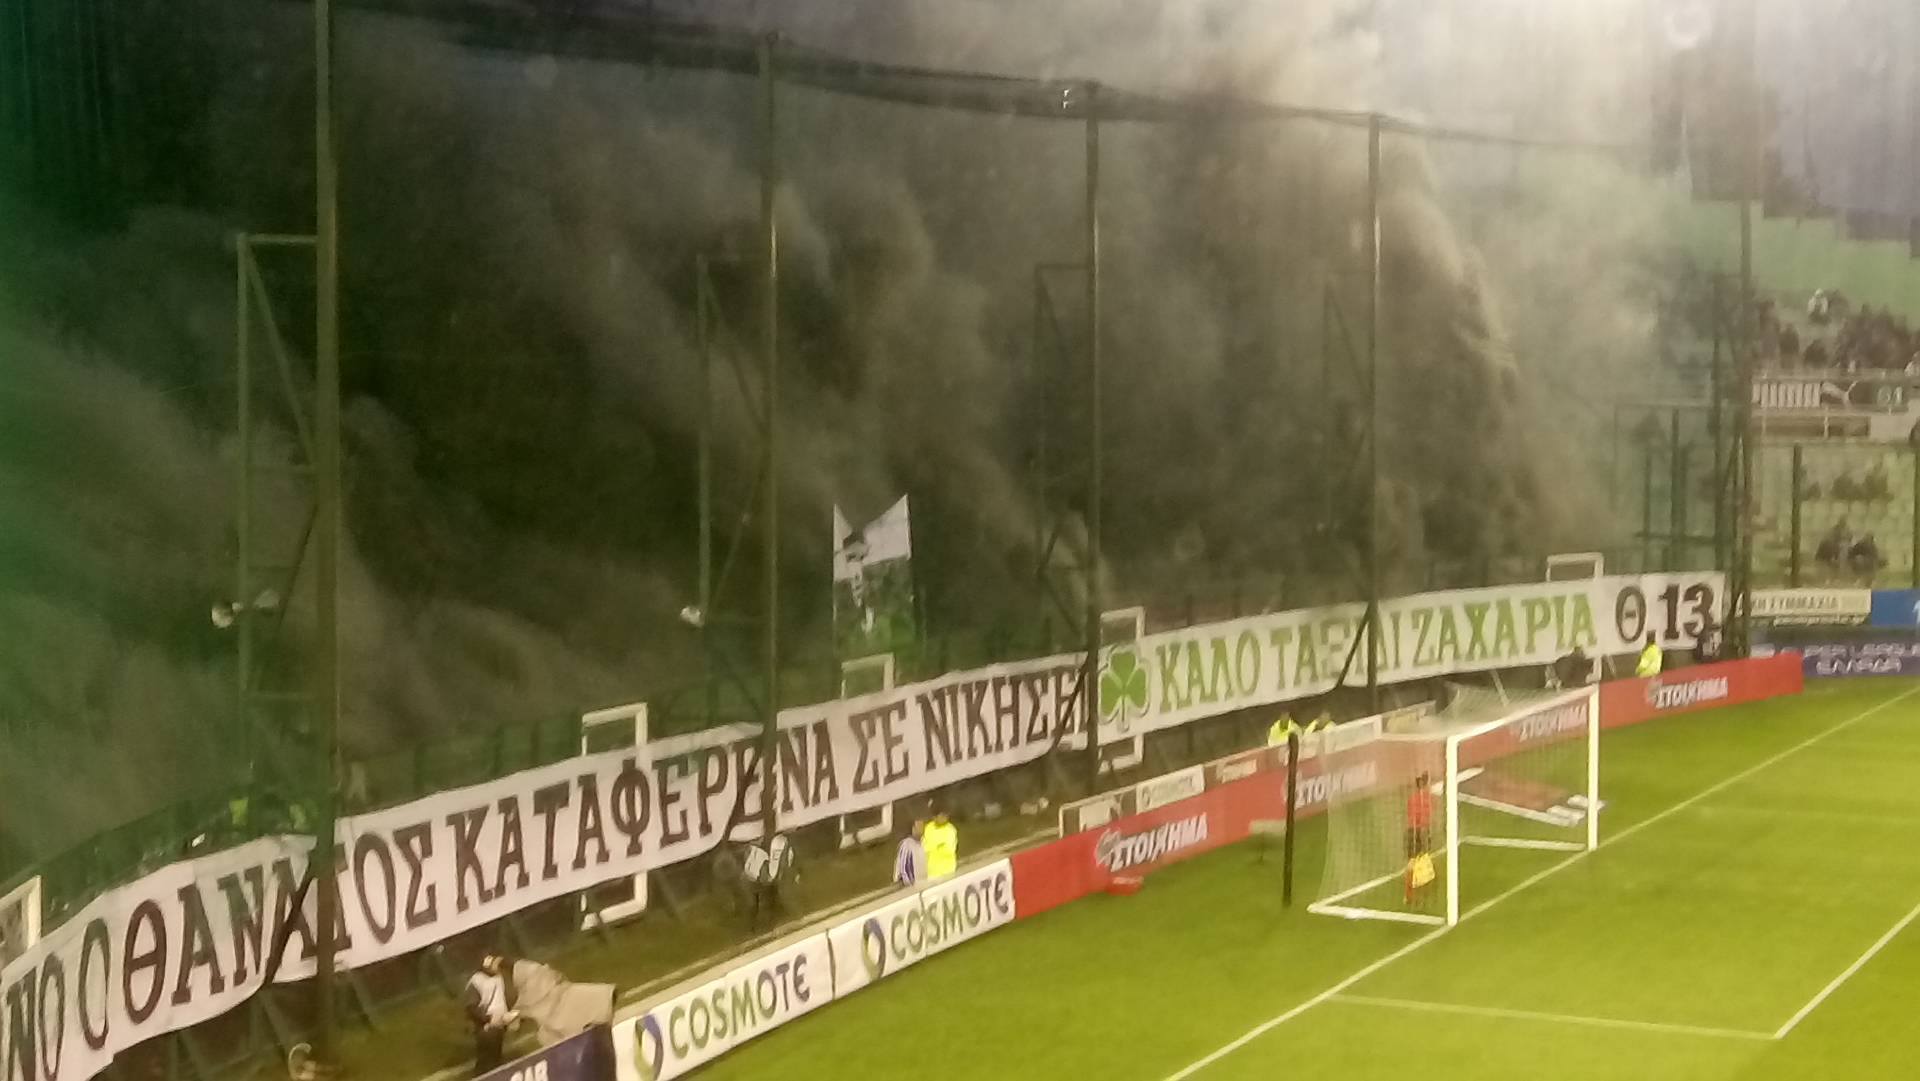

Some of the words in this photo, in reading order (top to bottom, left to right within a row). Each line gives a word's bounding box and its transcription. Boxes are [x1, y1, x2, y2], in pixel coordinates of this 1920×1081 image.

[1156, 629, 1261, 714] ΚΑΛΟ
[1411, 593, 1597, 668] ΖΑΧΑΡΙΑ
[78, 918, 111, 1050] Ο
[446, 738, 768, 913] ΚΑΤΑΦΕΡΕ
[776, 718, 839, 812] ΝΑ
[849, 699, 910, 795] ΣΕ
[891, 872, 1008, 960] COSMOTE
[669, 954, 810, 1049] COSMOTE
